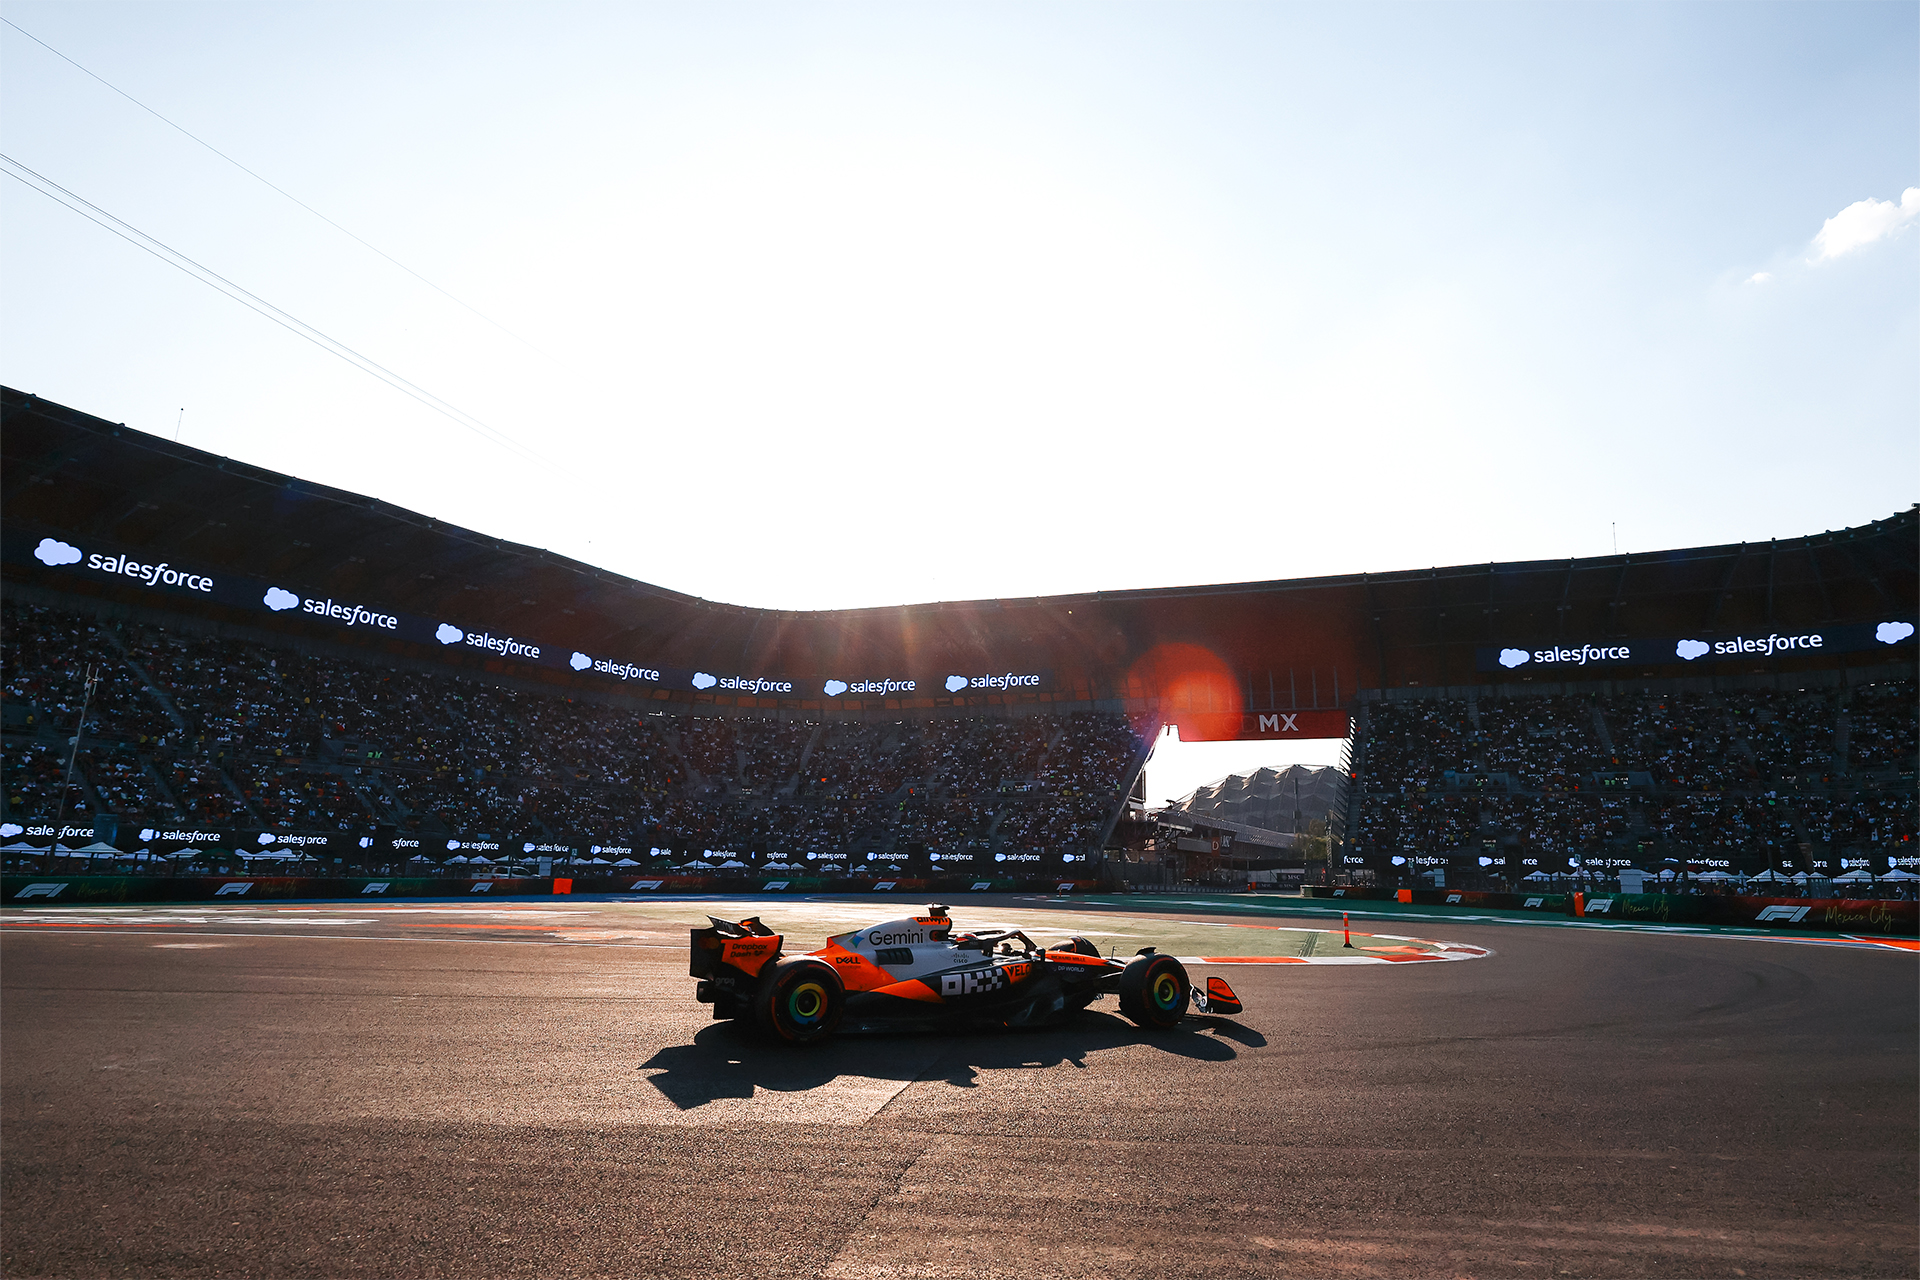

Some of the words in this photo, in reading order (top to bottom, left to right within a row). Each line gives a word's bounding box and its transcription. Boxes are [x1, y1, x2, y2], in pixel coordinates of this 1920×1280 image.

[87, 553, 214, 592] salesforce
[302, 598, 398, 630] salesforce
[465, 631, 541, 659] salesforce
[1533, 643, 1631, 666] salesforce
[1714, 633, 1823, 656] salesforce
[593, 658, 660, 682] salesforce
[719, 675, 793, 695] salesforce
[849, 677, 917, 696] salesforce
[970, 672, 1040, 691] salesforce
[25, 824, 95, 840] saleforce
[161, 830, 221, 844] salesforce
[461, 840, 500, 852] saesforce
[1584, 857, 1632, 868] saleforce
[1825, 905, 1866, 925] Mexico
[1869, 902, 1895, 932] City
[869, 928, 923, 946] Gemini
